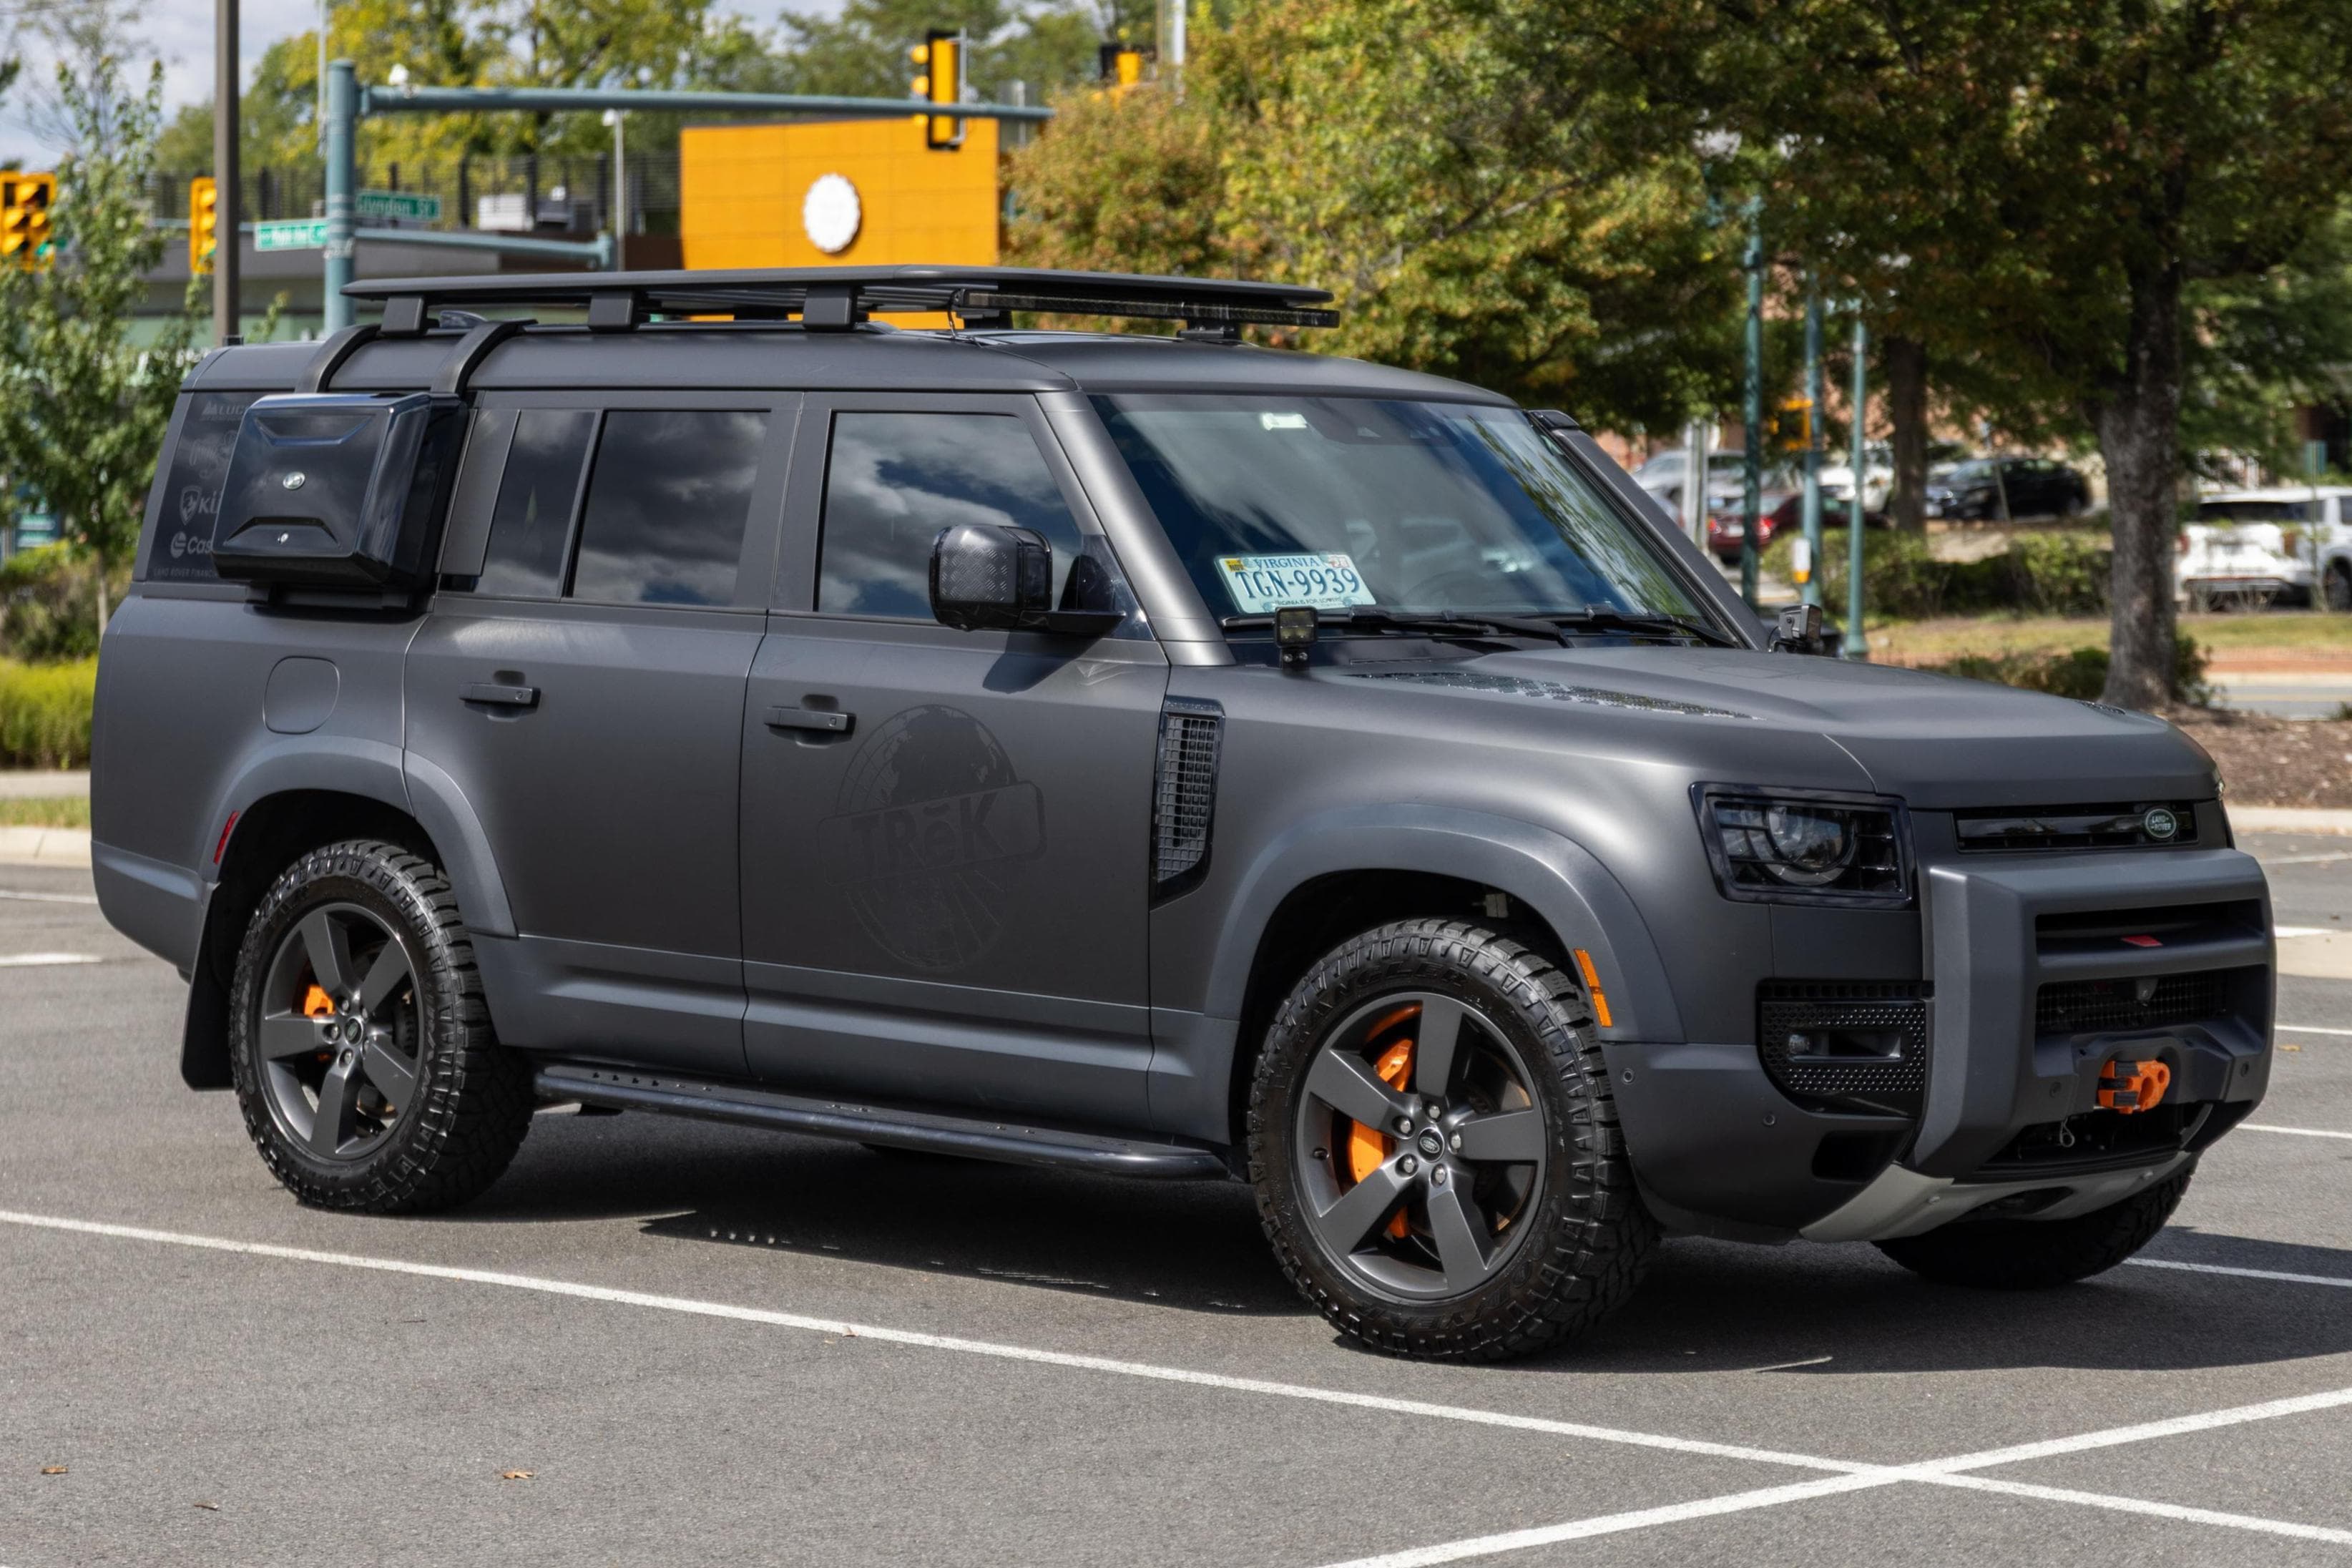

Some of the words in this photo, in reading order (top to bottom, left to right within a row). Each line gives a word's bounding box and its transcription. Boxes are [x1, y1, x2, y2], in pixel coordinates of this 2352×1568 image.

[187, 536, 212, 554] Cas
[1253, 557, 1320, 571] VIRGINIA
[1235, 568, 1360, 599] TGN-9939
